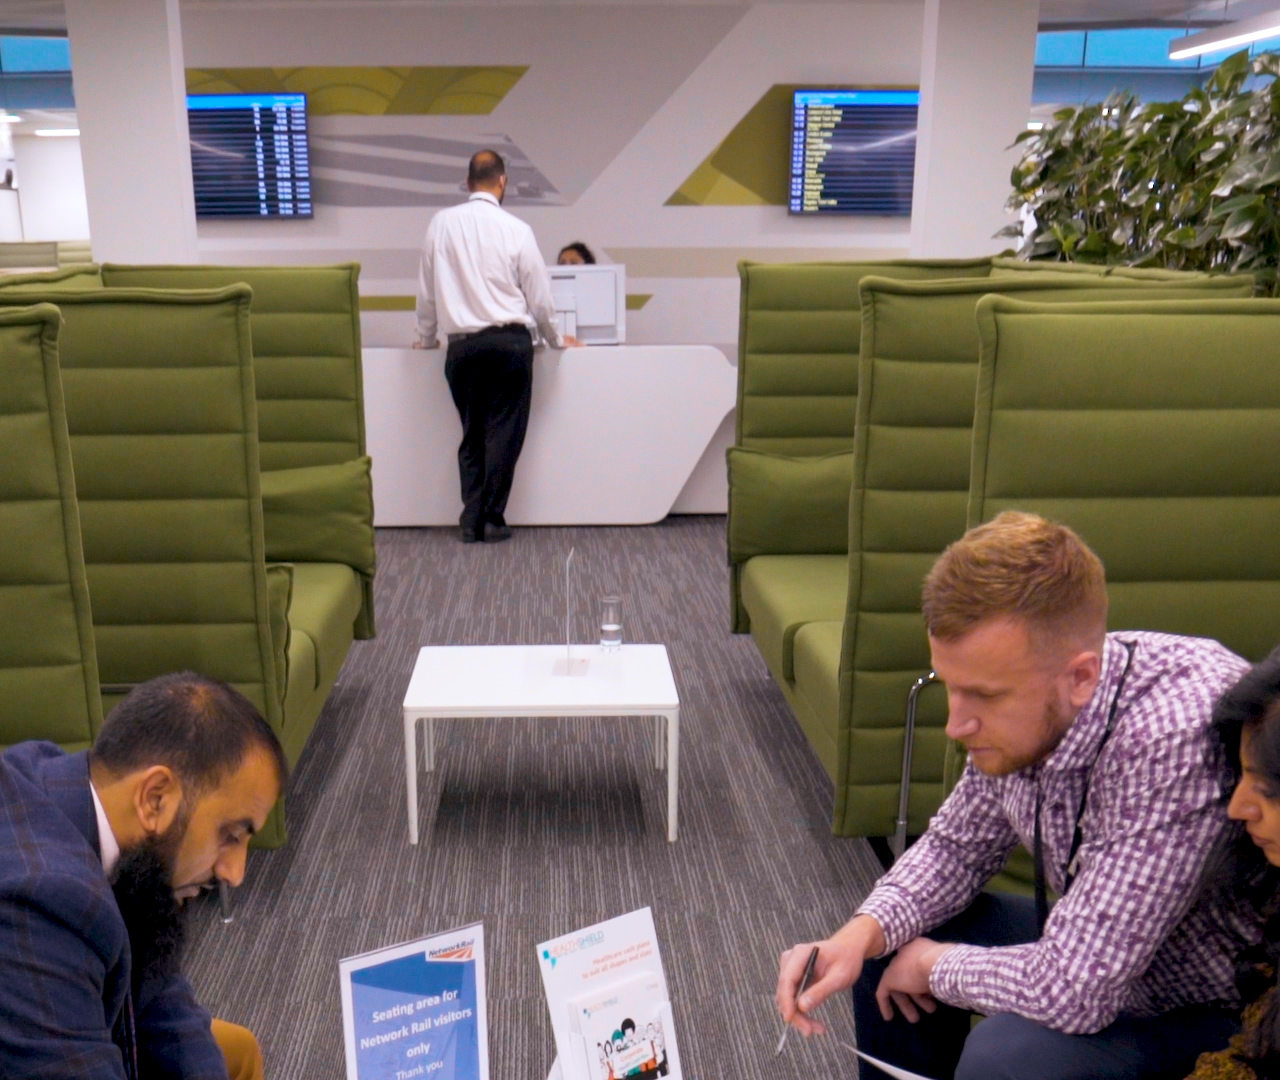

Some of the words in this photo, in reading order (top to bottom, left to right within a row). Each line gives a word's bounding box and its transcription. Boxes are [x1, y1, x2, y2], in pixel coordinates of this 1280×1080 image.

[372, 1002, 414, 1023] Seating
[416, 995, 440, 1011] area
[442, 989, 458, 1003] for
[360, 1026, 408, 1050] Network
[411, 1017, 431, 1035] Rail
[433, 1007, 472, 1027] visitors
[406, 1042, 430, 1058] only
[426, 1060, 443, 1073] you
